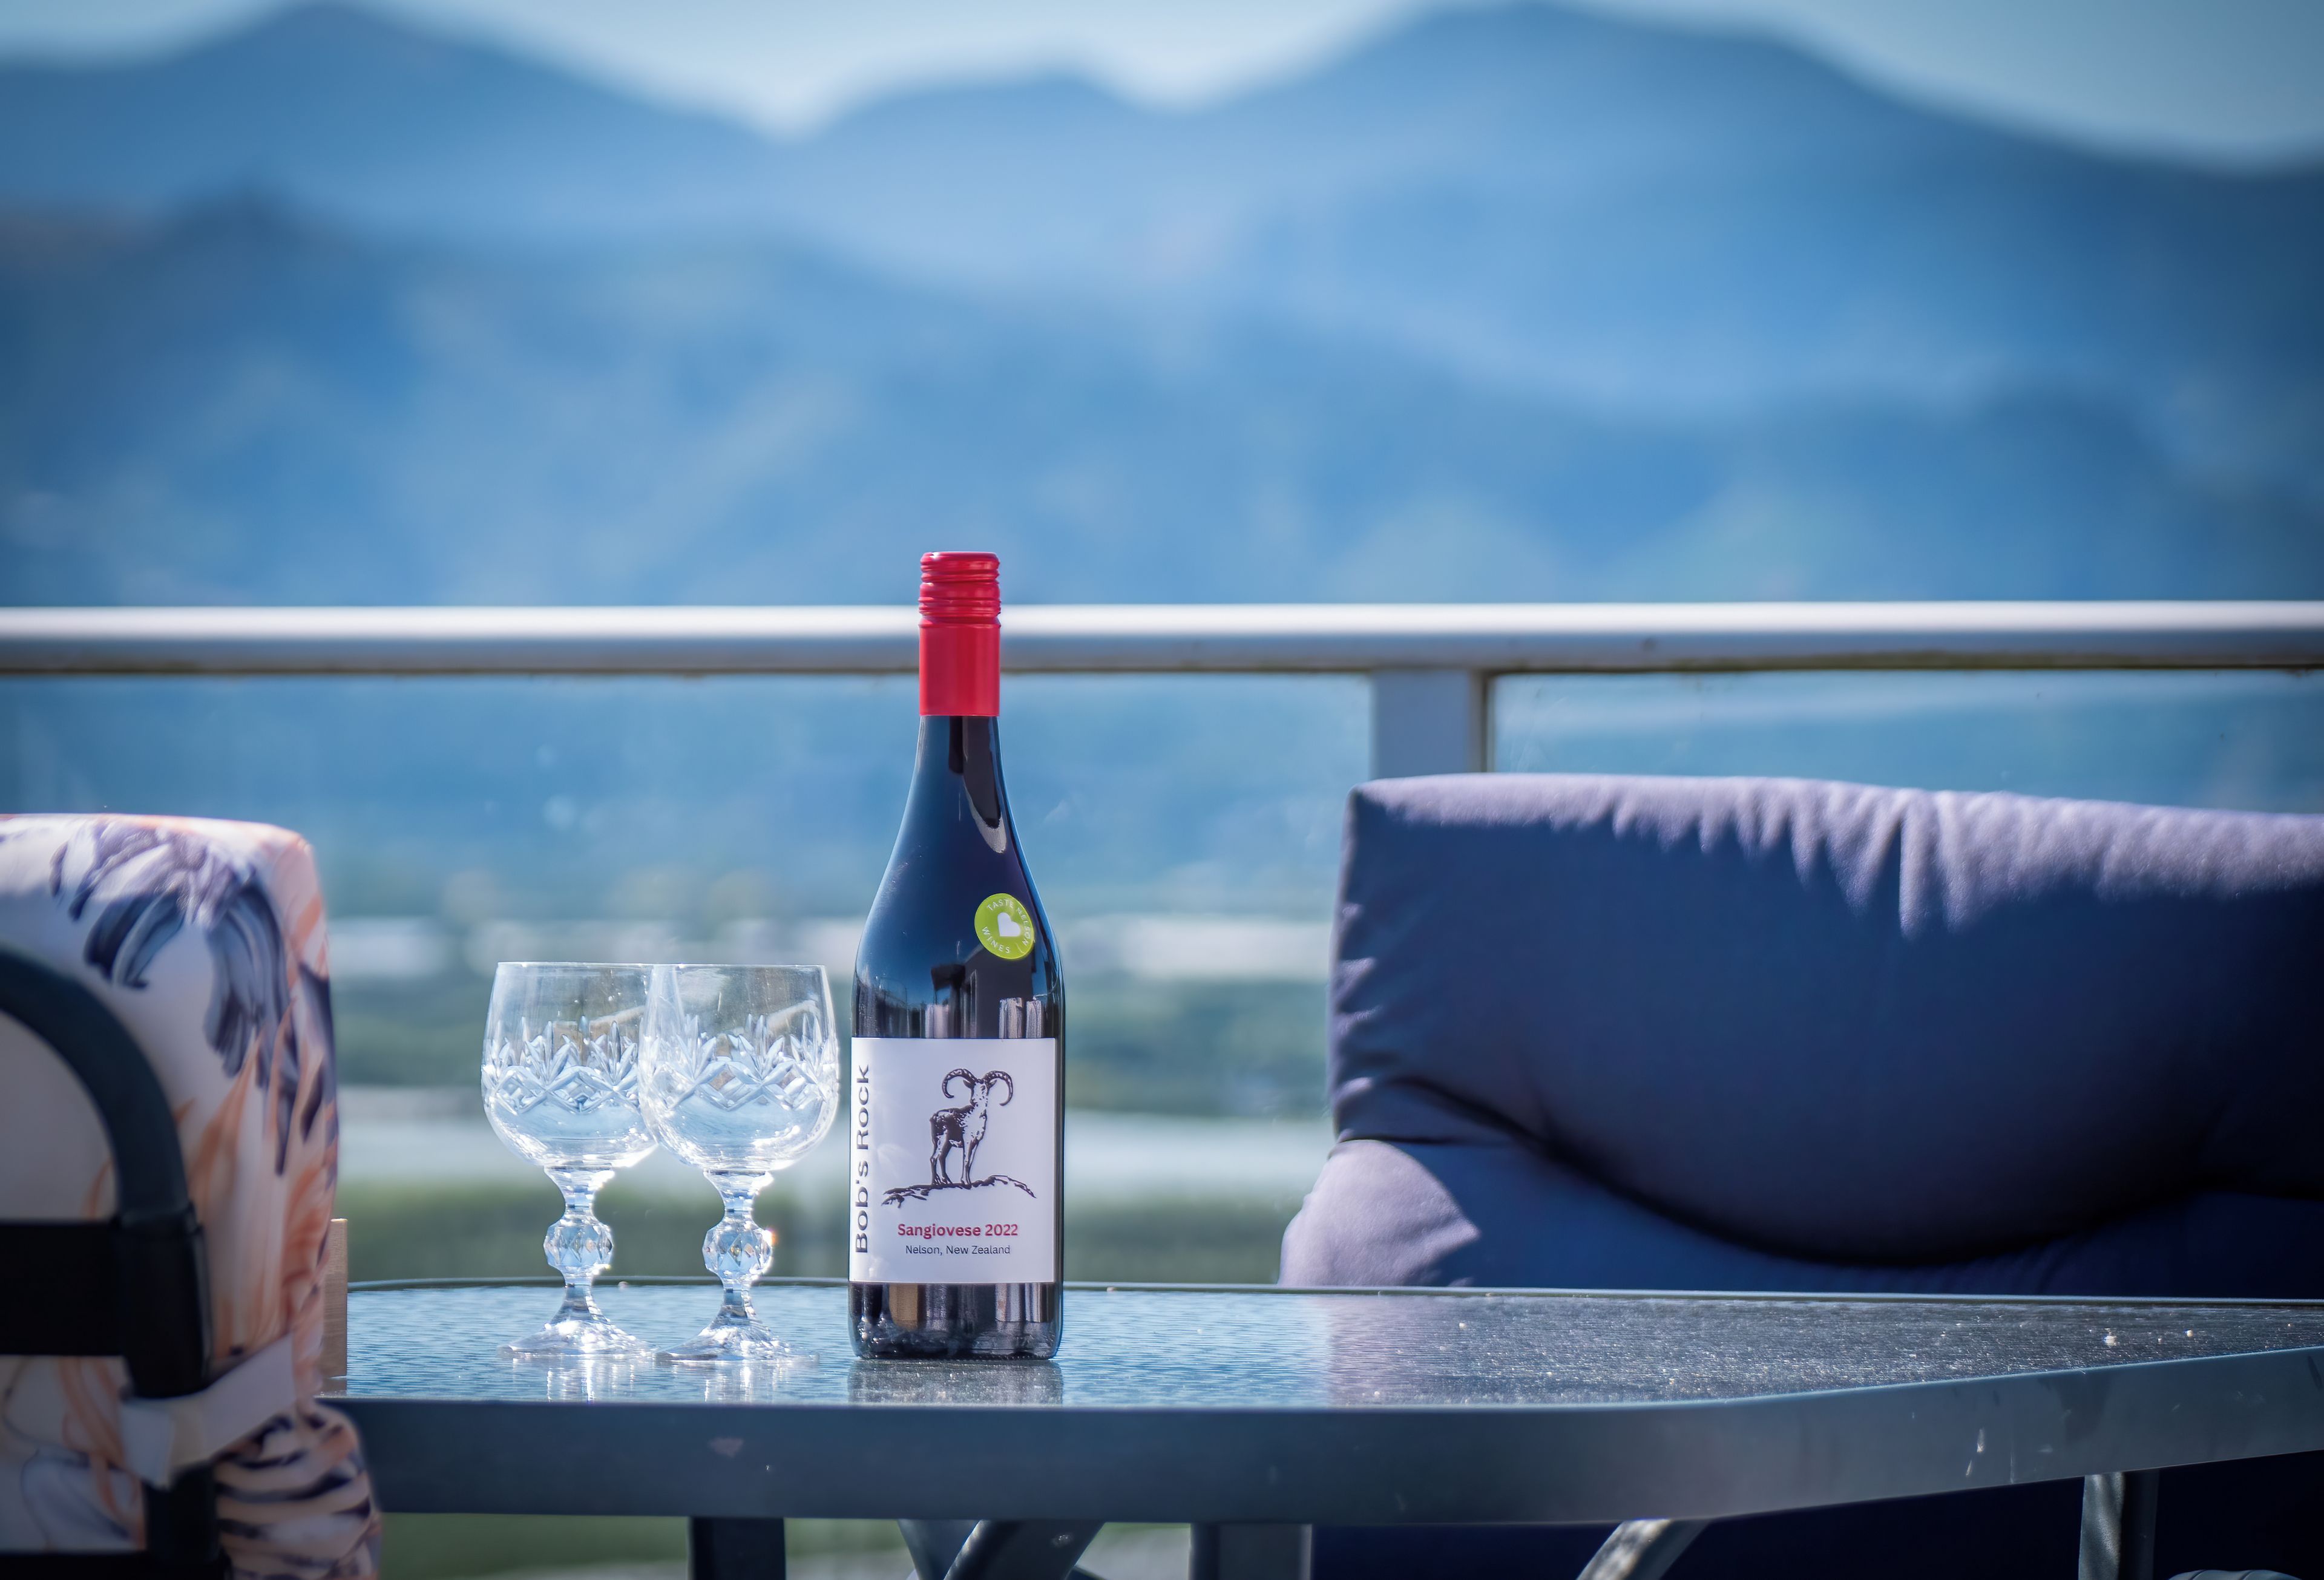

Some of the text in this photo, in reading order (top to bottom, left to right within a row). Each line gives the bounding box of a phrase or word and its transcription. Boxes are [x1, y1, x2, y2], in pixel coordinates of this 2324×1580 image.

[987, 899, 1031, 946] TASTE NELSON
[982, 926, 1011, 954] WINES
[855, 1064, 869, 1253] Bob's Rock
[898, 1223, 1019, 1239] Sangiovese 2022
[905, 1245, 1011, 1256] Nelson, New Zealand
